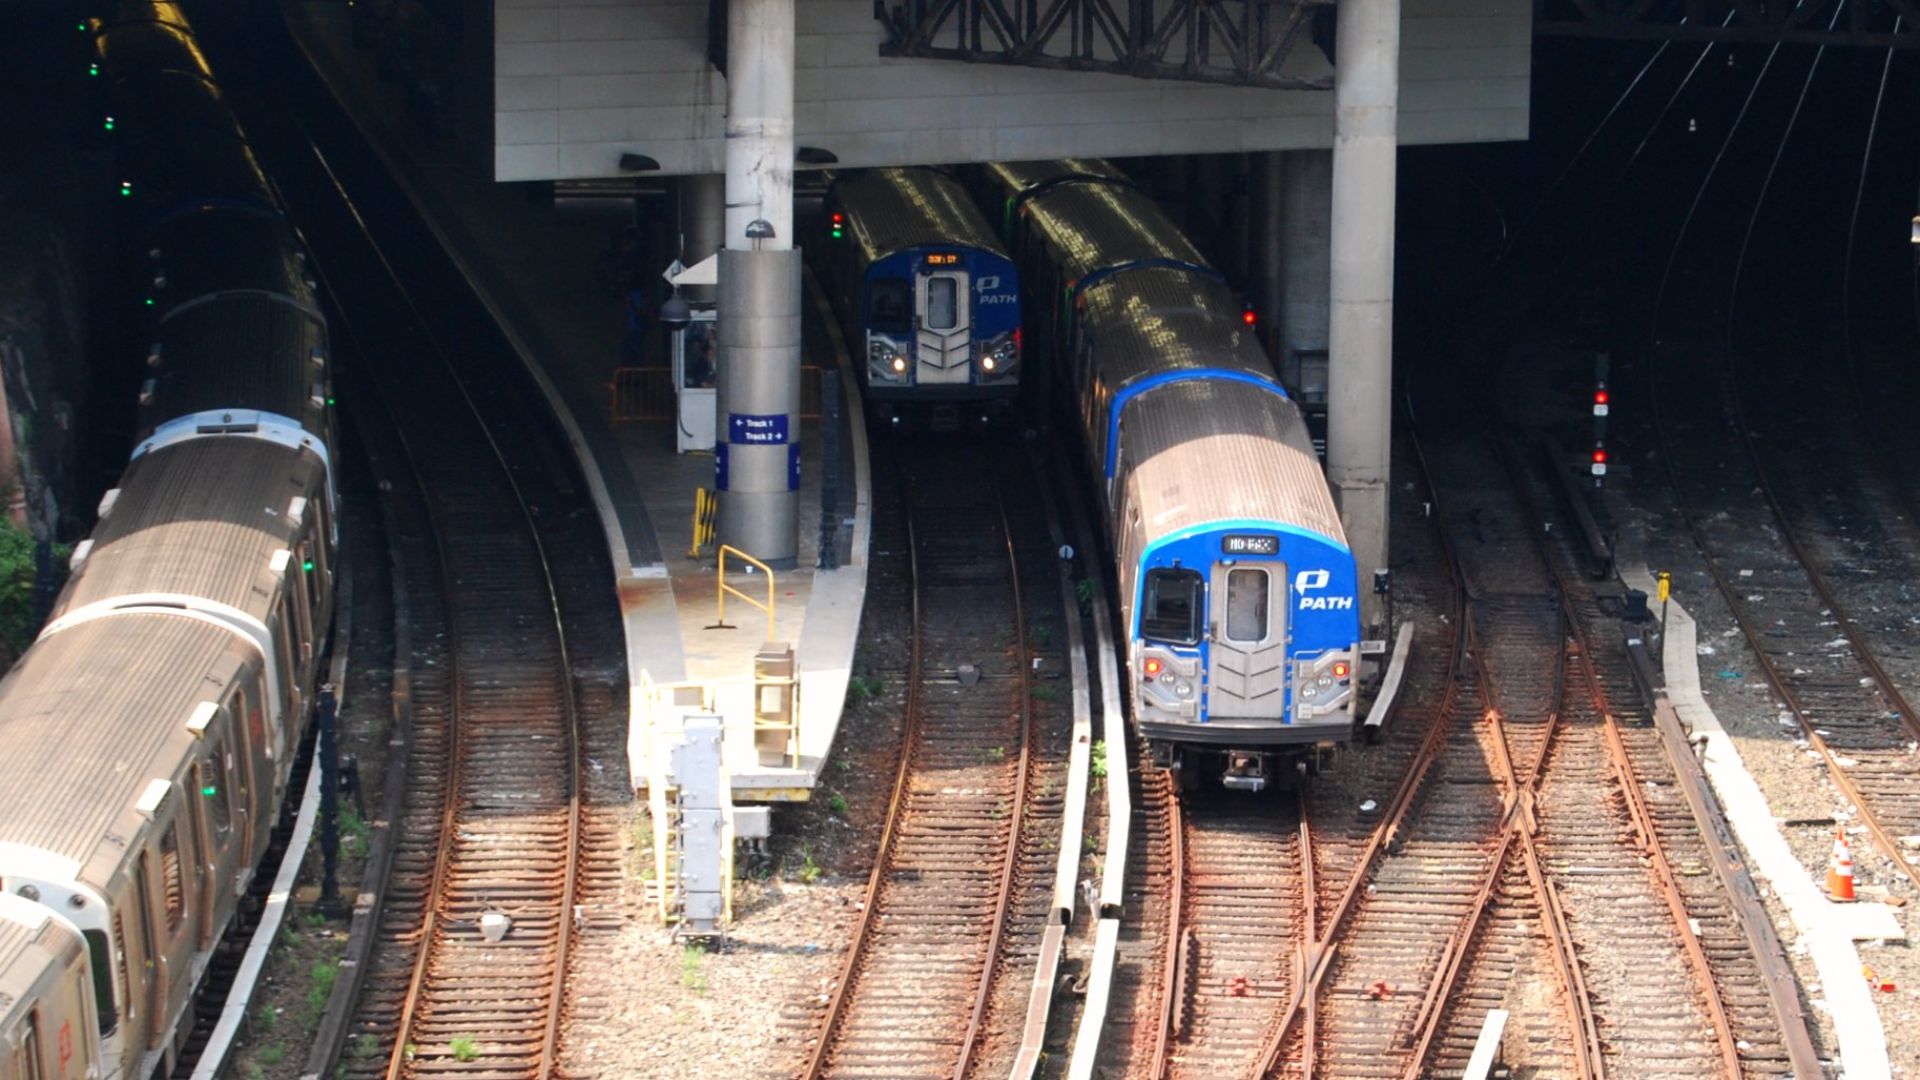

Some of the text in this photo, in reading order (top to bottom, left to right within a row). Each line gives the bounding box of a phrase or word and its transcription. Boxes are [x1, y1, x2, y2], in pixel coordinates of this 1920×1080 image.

[979, 294, 1017, 304] PATH
[745, 419, 766, 428] Track
[744, 431, 766, 440] Track
[1299, 596, 1353, 610] PATH
